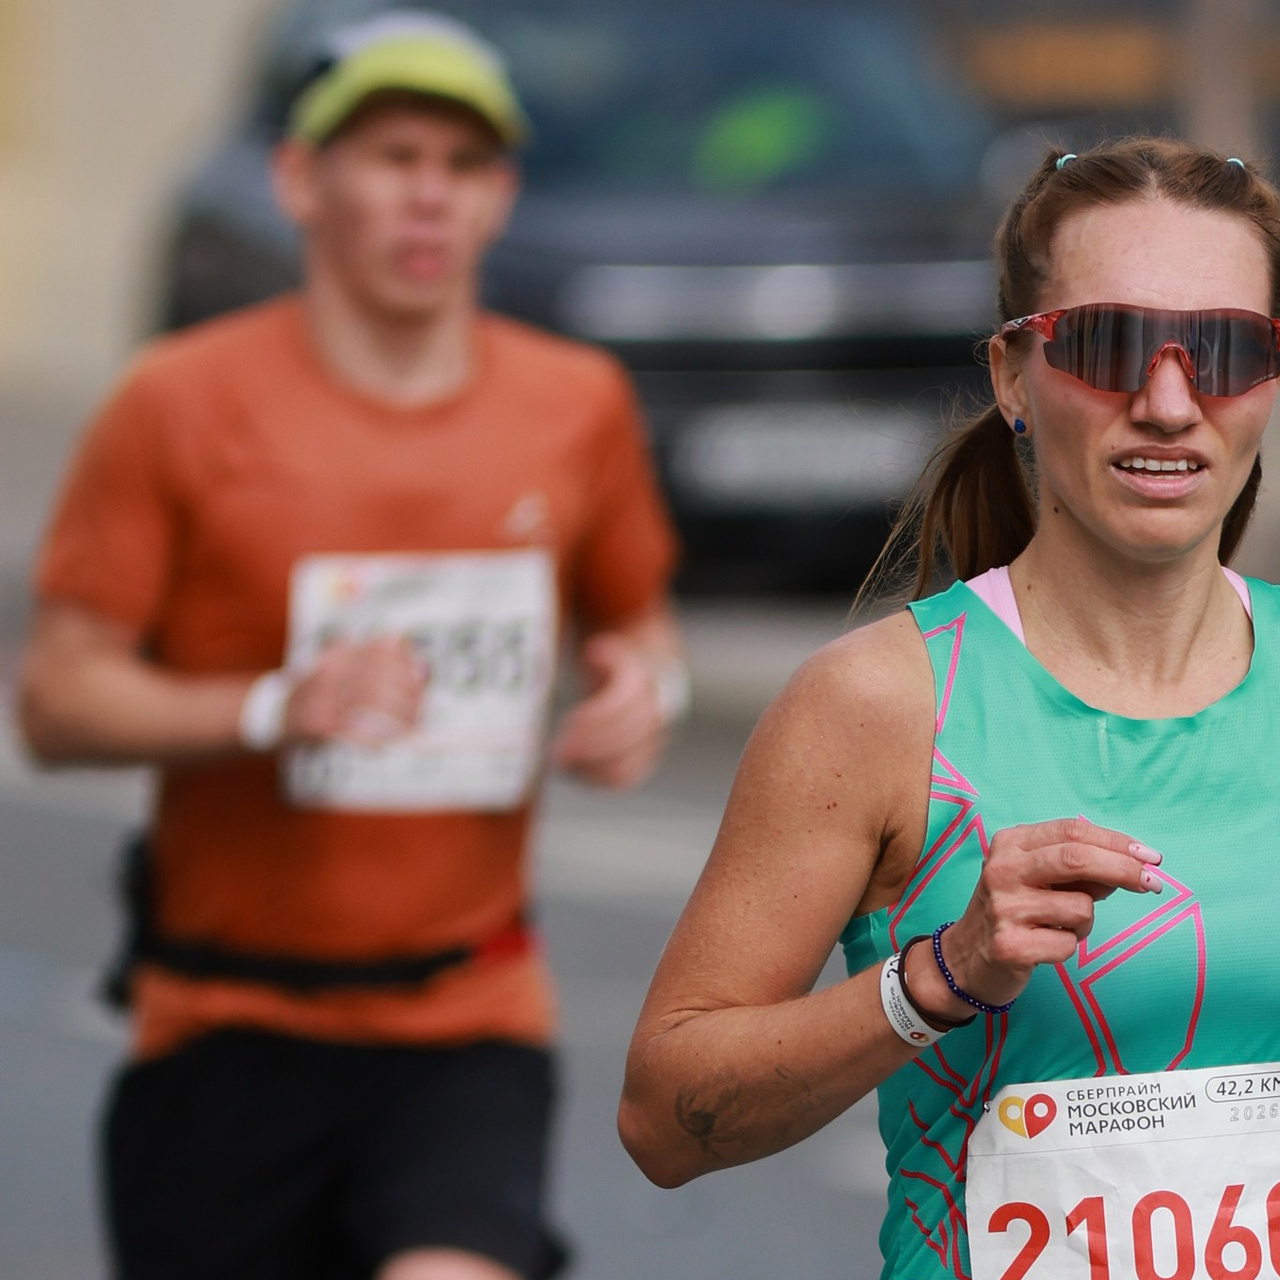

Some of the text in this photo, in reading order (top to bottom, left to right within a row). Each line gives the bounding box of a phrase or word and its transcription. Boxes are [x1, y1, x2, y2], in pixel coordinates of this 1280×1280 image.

[1066, 1082, 1162, 1102] СБЕРПРАЙМ
[1216, 1079, 1254, 1097] 42,2
[1067, 1092, 1197, 1119] МОСКОВСКИЙ
[1230, 1103, 1280, 1122] 2026
[1069, 1114, 1165, 1136] МАРАФОН
